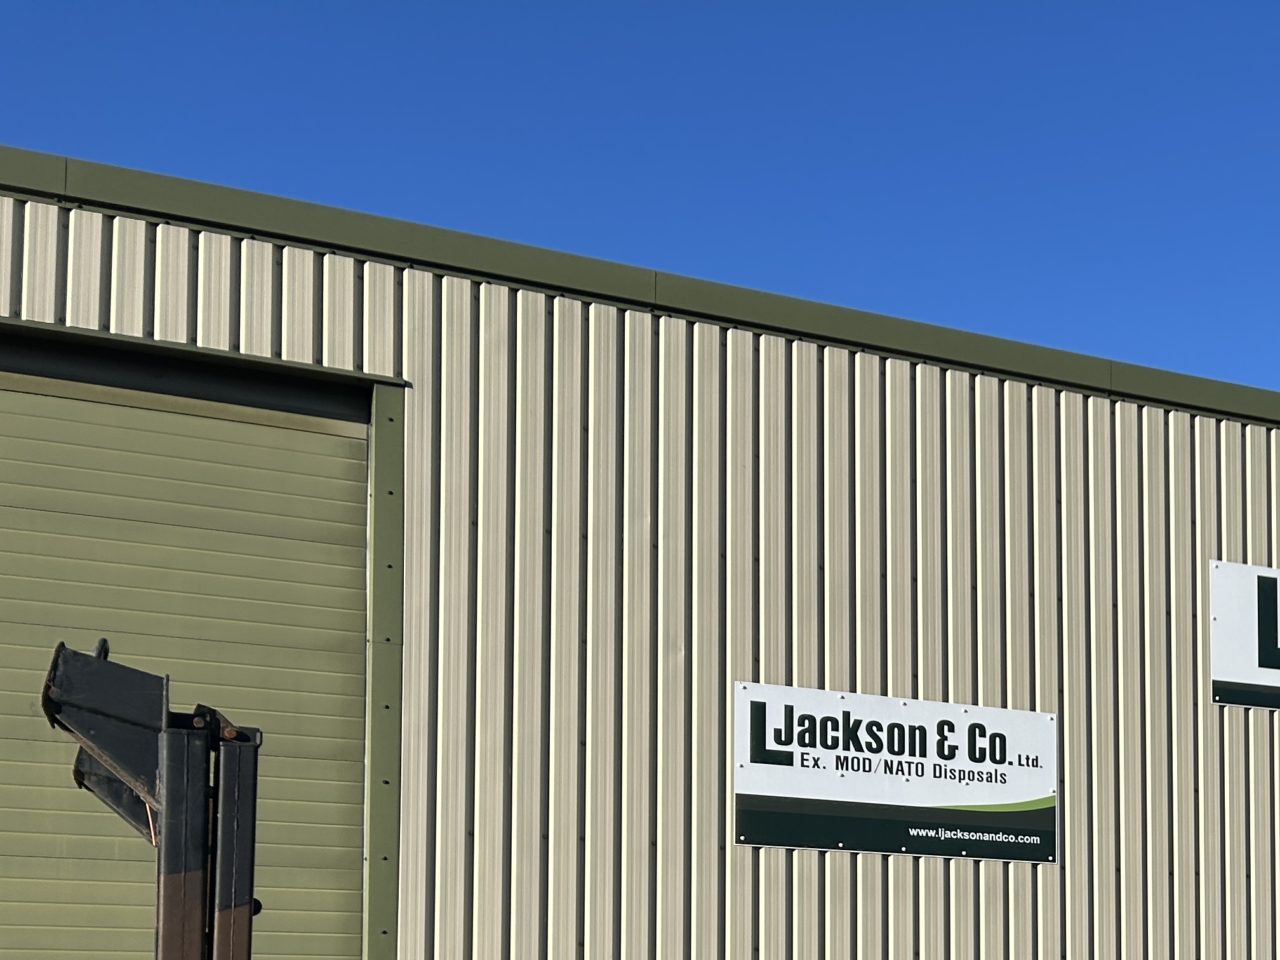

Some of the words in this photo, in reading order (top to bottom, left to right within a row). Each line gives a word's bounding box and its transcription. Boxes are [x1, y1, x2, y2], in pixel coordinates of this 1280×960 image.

[936, 719, 959, 760] &
[967, 722, 1013, 766] Co.
[1018, 753, 1043, 769] Ltd.
[800, 752, 827, 770] Ex.
[835, 755, 924, 778] MOD/NATO
[933, 763, 1008, 785] Disposals
[908, 826, 1041, 845] www.ljacksonandco.com
